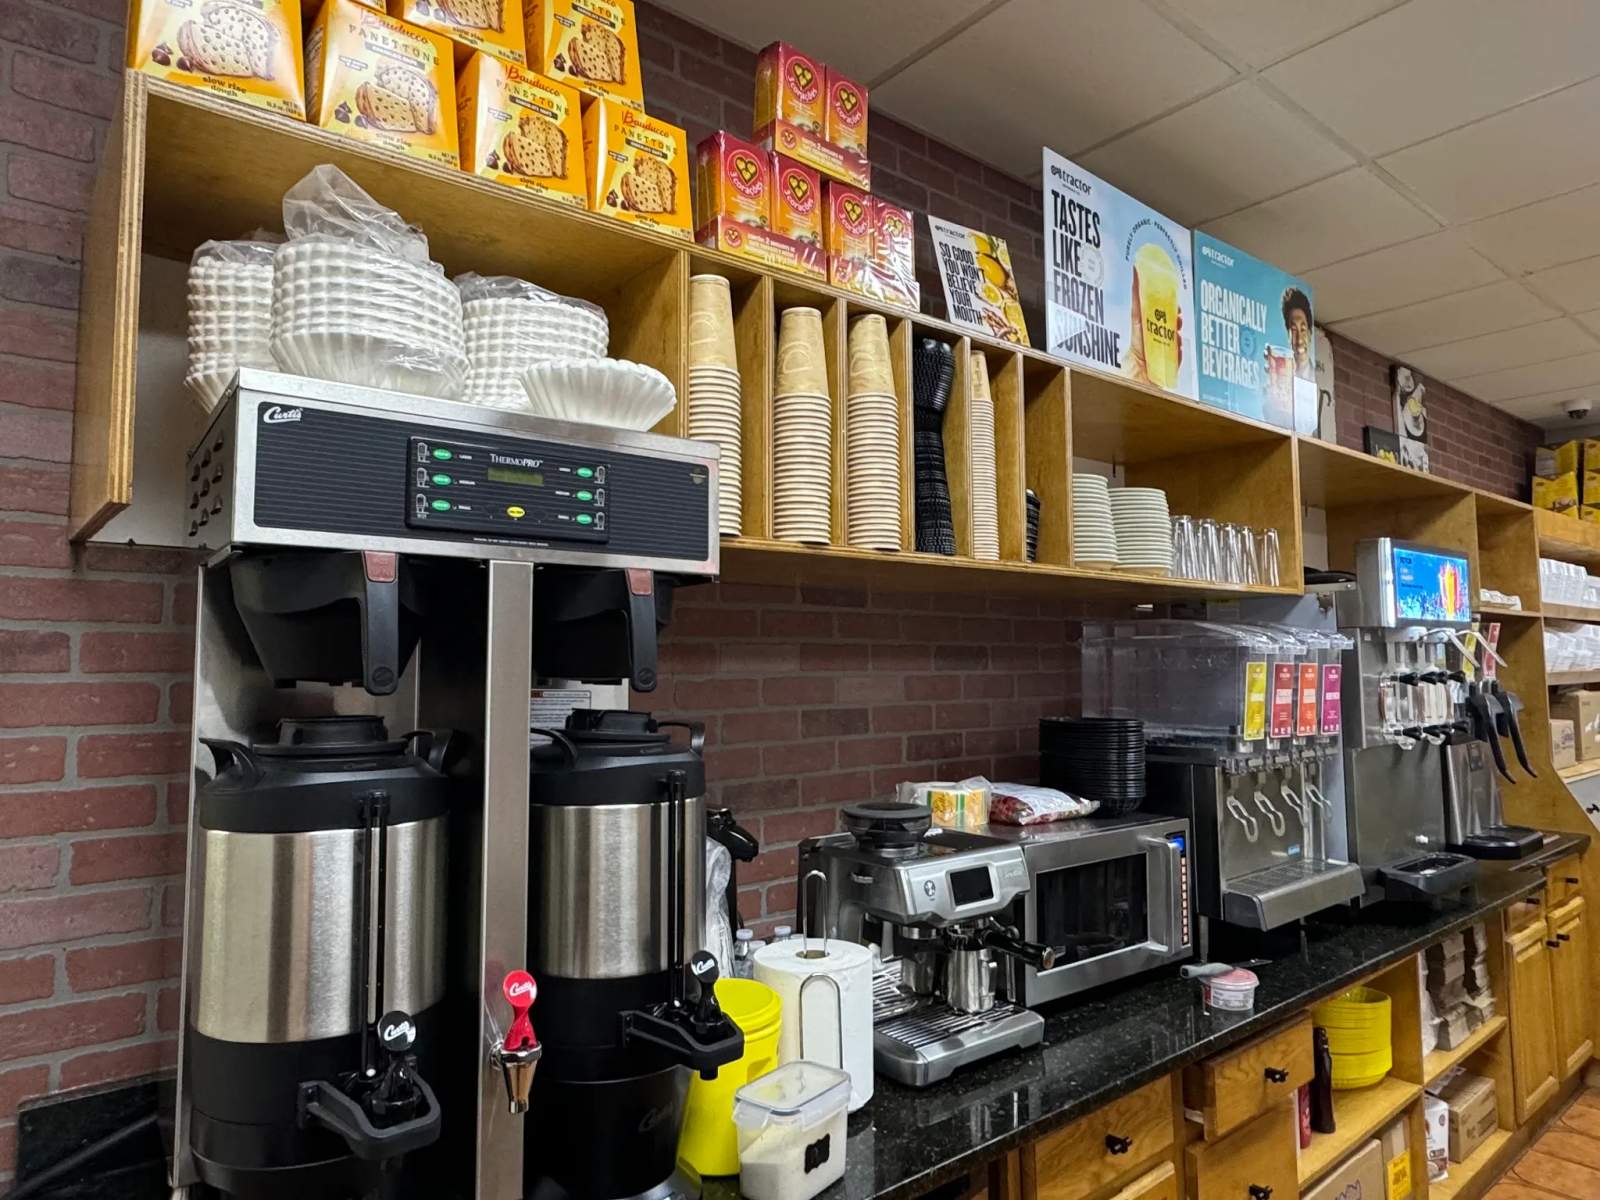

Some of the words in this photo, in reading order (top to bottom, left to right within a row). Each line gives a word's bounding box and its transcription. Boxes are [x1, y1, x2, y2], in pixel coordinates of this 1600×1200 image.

[349, 24, 440, 66] PANETTONE
[505, 65, 560, 97] Bauducco
[496, 79, 570, 117] PANETTONE
[613, 124, 678, 155] PANETTONE
[622, 110, 670, 138] Bauducco
[1062, 170, 1092, 196] tractor
[1051, 189, 1101, 249] TASTES
[939, 241, 952, 259] SO
[952, 246, 975, 266] GOOD
[942, 256, 961, 276] YOU
[1052, 230, 1082, 278] LIKE
[1211, 248, 1235, 268] tractor
[946, 272, 977, 295] BELIEVE
[949, 287, 973, 308] YOUR
[1053, 269, 1104, 326] FROZEN
[952, 304, 983, 326] MOUTH
[1200, 279, 1268, 335] ORGANICALLY
[1054, 309, 1122, 369] SUNSHINE
[1146, 318, 1175, 342] tractor
[1201, 311, 1241, 355] BETTER
[1202, 344, 1261, 387] BEVERAGES
[263, 406, 301, 424] Curtis
